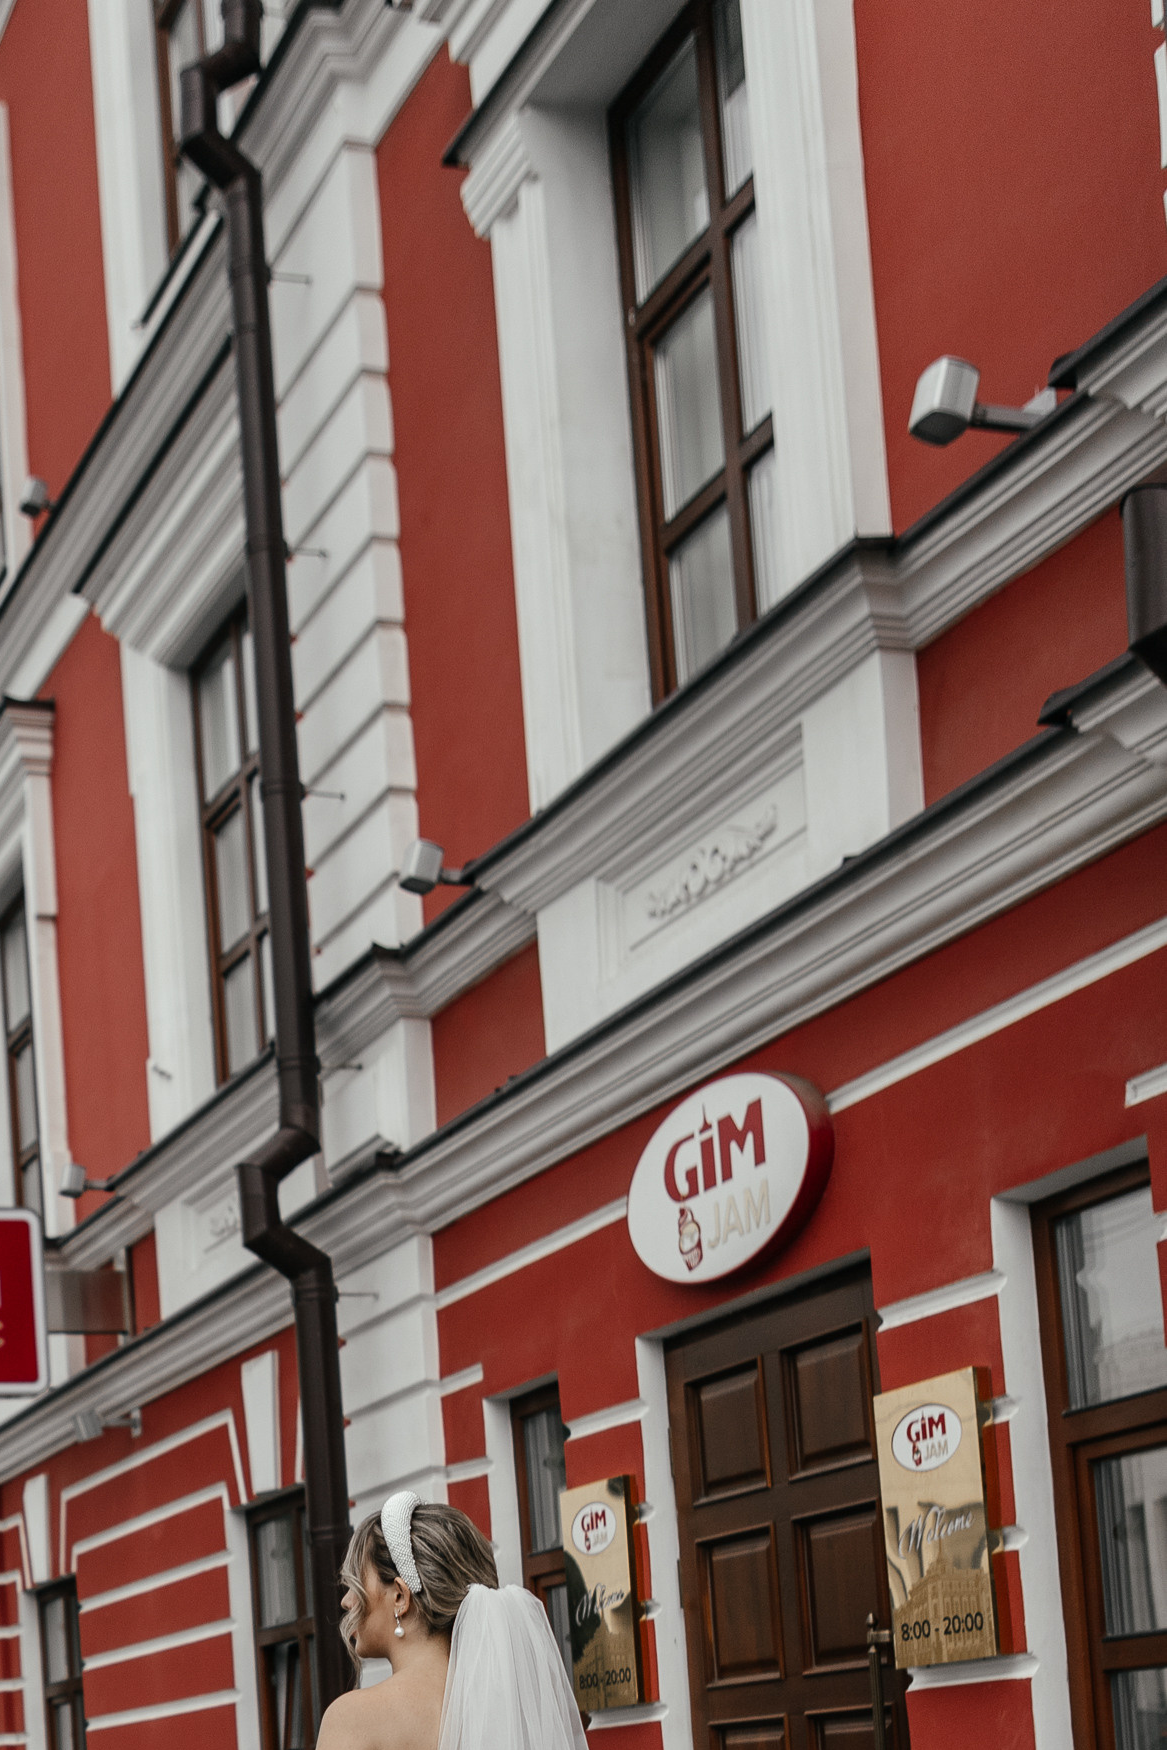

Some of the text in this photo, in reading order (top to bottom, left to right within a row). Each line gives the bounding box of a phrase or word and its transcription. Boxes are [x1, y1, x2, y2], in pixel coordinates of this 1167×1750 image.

[707, 1179, 771, 1249] JAM
[924, 1440, 949, 1461] JAM
[898, 1506, 974, 1560] Welcome
[901, 1619, 931, 1641] 8:00
[943, 1611, 984, 1635] 20:00
[579, 1672, 598, 1690] 8:00
[605, 1667, 631, 1685] 20:00
